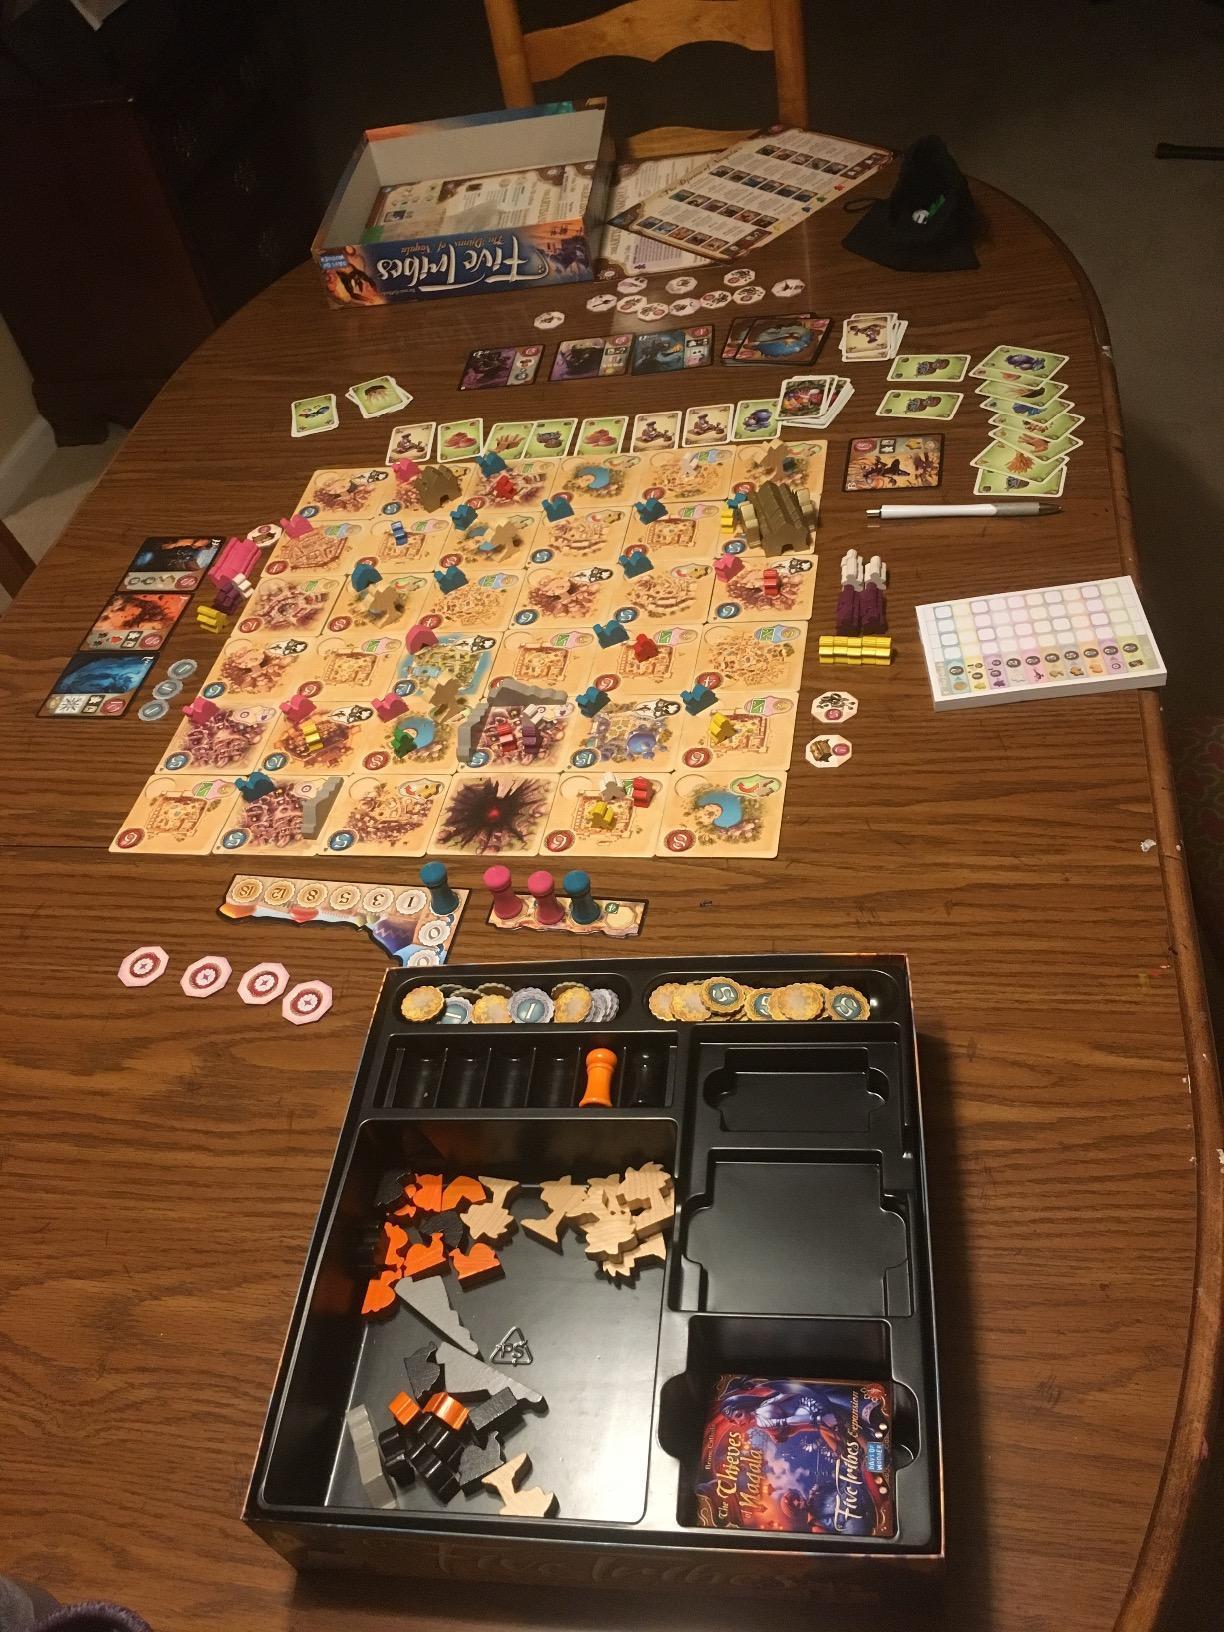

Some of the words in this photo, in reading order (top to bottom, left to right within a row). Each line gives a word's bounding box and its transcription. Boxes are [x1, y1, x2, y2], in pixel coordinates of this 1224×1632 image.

[376, 244, 486, 291] Tribes
[462, 235, 549, 283] Five
[847, 1391, 862, 1438] Expansion
[716, 1431, 742, 1498] Thieves
[739, 1449, 764, 1510] Naqala
[835, 1440, 862, 1494] Tribes
[868, 1453, 876, 1470] DAYS
[718, 1501, 729, 1519] The
[835, 1486, 863, 1531] Five
